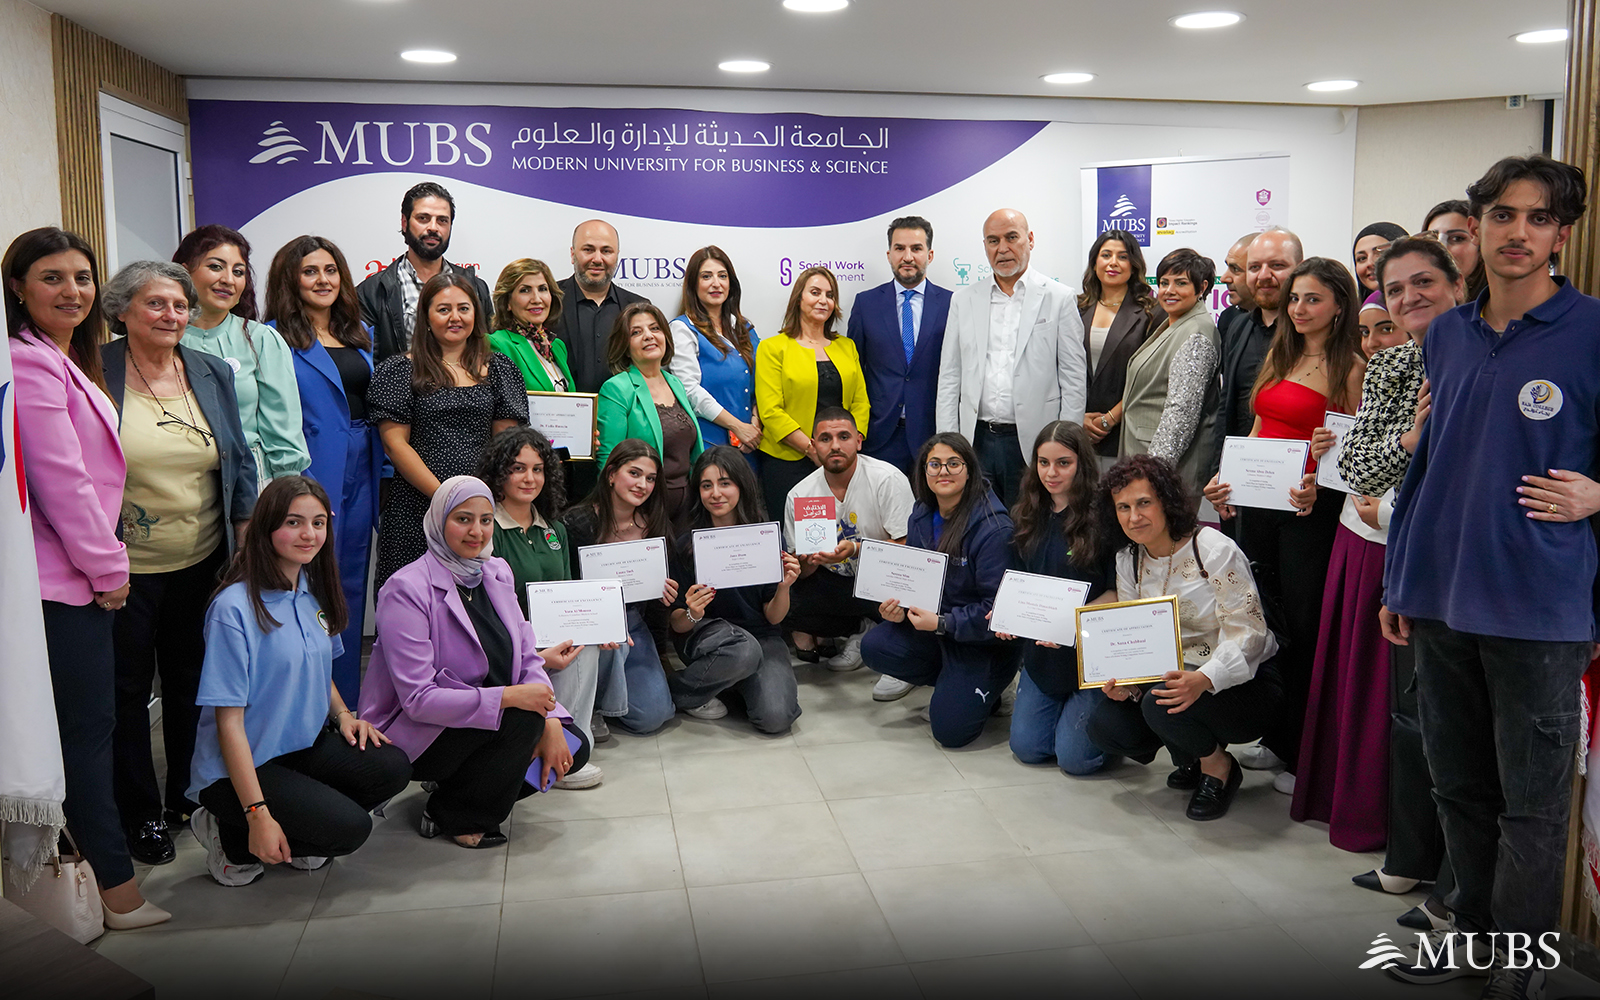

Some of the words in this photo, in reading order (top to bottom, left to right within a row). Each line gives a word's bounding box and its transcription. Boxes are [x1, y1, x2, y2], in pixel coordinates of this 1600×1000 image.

[313, 121, 493, 167] MUBS
[511, 122, 616, 152] والعلوم
[621, 122, 689, 152] للإدارة
[695, 120, 785, 153] الحديثة
[790, 125, 889, 155] الجامعة
[512, 156, 588, 171] MODERN
[594, 157, 689, 172] UNIVERSITY
[694, 158, 726, 173] FOR
[731, 159, 805, 174] BUSINESS
[810, 160, 821, 173] &
[825, 160, 889, 174] SCIENCE
[1101, 218, 1146, 233] MUBS
[834, 260, 865, 270] Work
